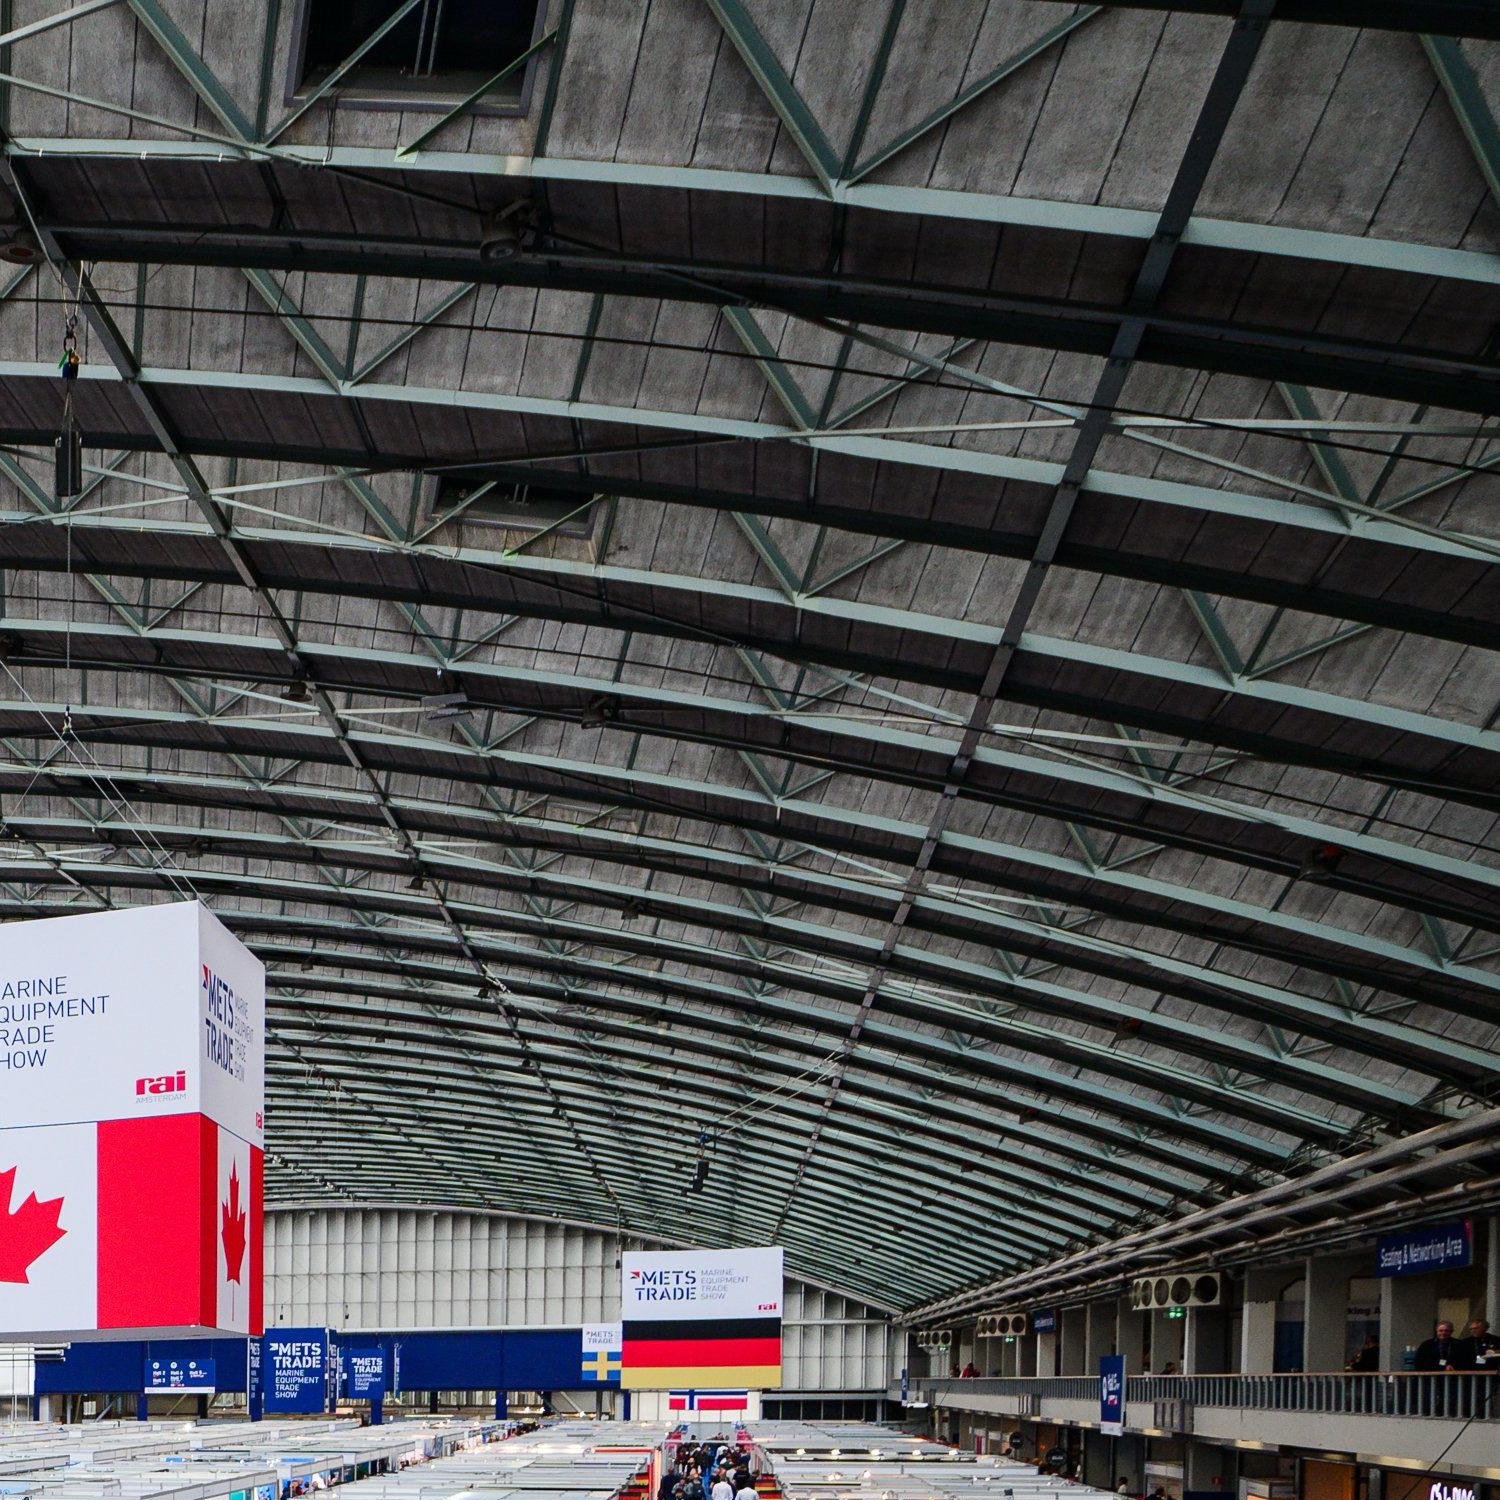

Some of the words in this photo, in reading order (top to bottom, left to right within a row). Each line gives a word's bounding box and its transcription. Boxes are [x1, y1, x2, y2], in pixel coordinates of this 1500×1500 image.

[208, 970, 233, 1030] METS
[206, 1018, 233, 1076] TRADE
[136, 1070, 186, 1096] rai
[135, 1093, 187, 1104] AMSTERDAM
[642, 1271, 696, 1285] METS
[701, 1276, 749, 1284] EQUIPMENT
[635, 1287, 696, 1301] TRADE
[279, 1343, 321, 1355] METS
[273, 1356, 321, 1368] TRADE
